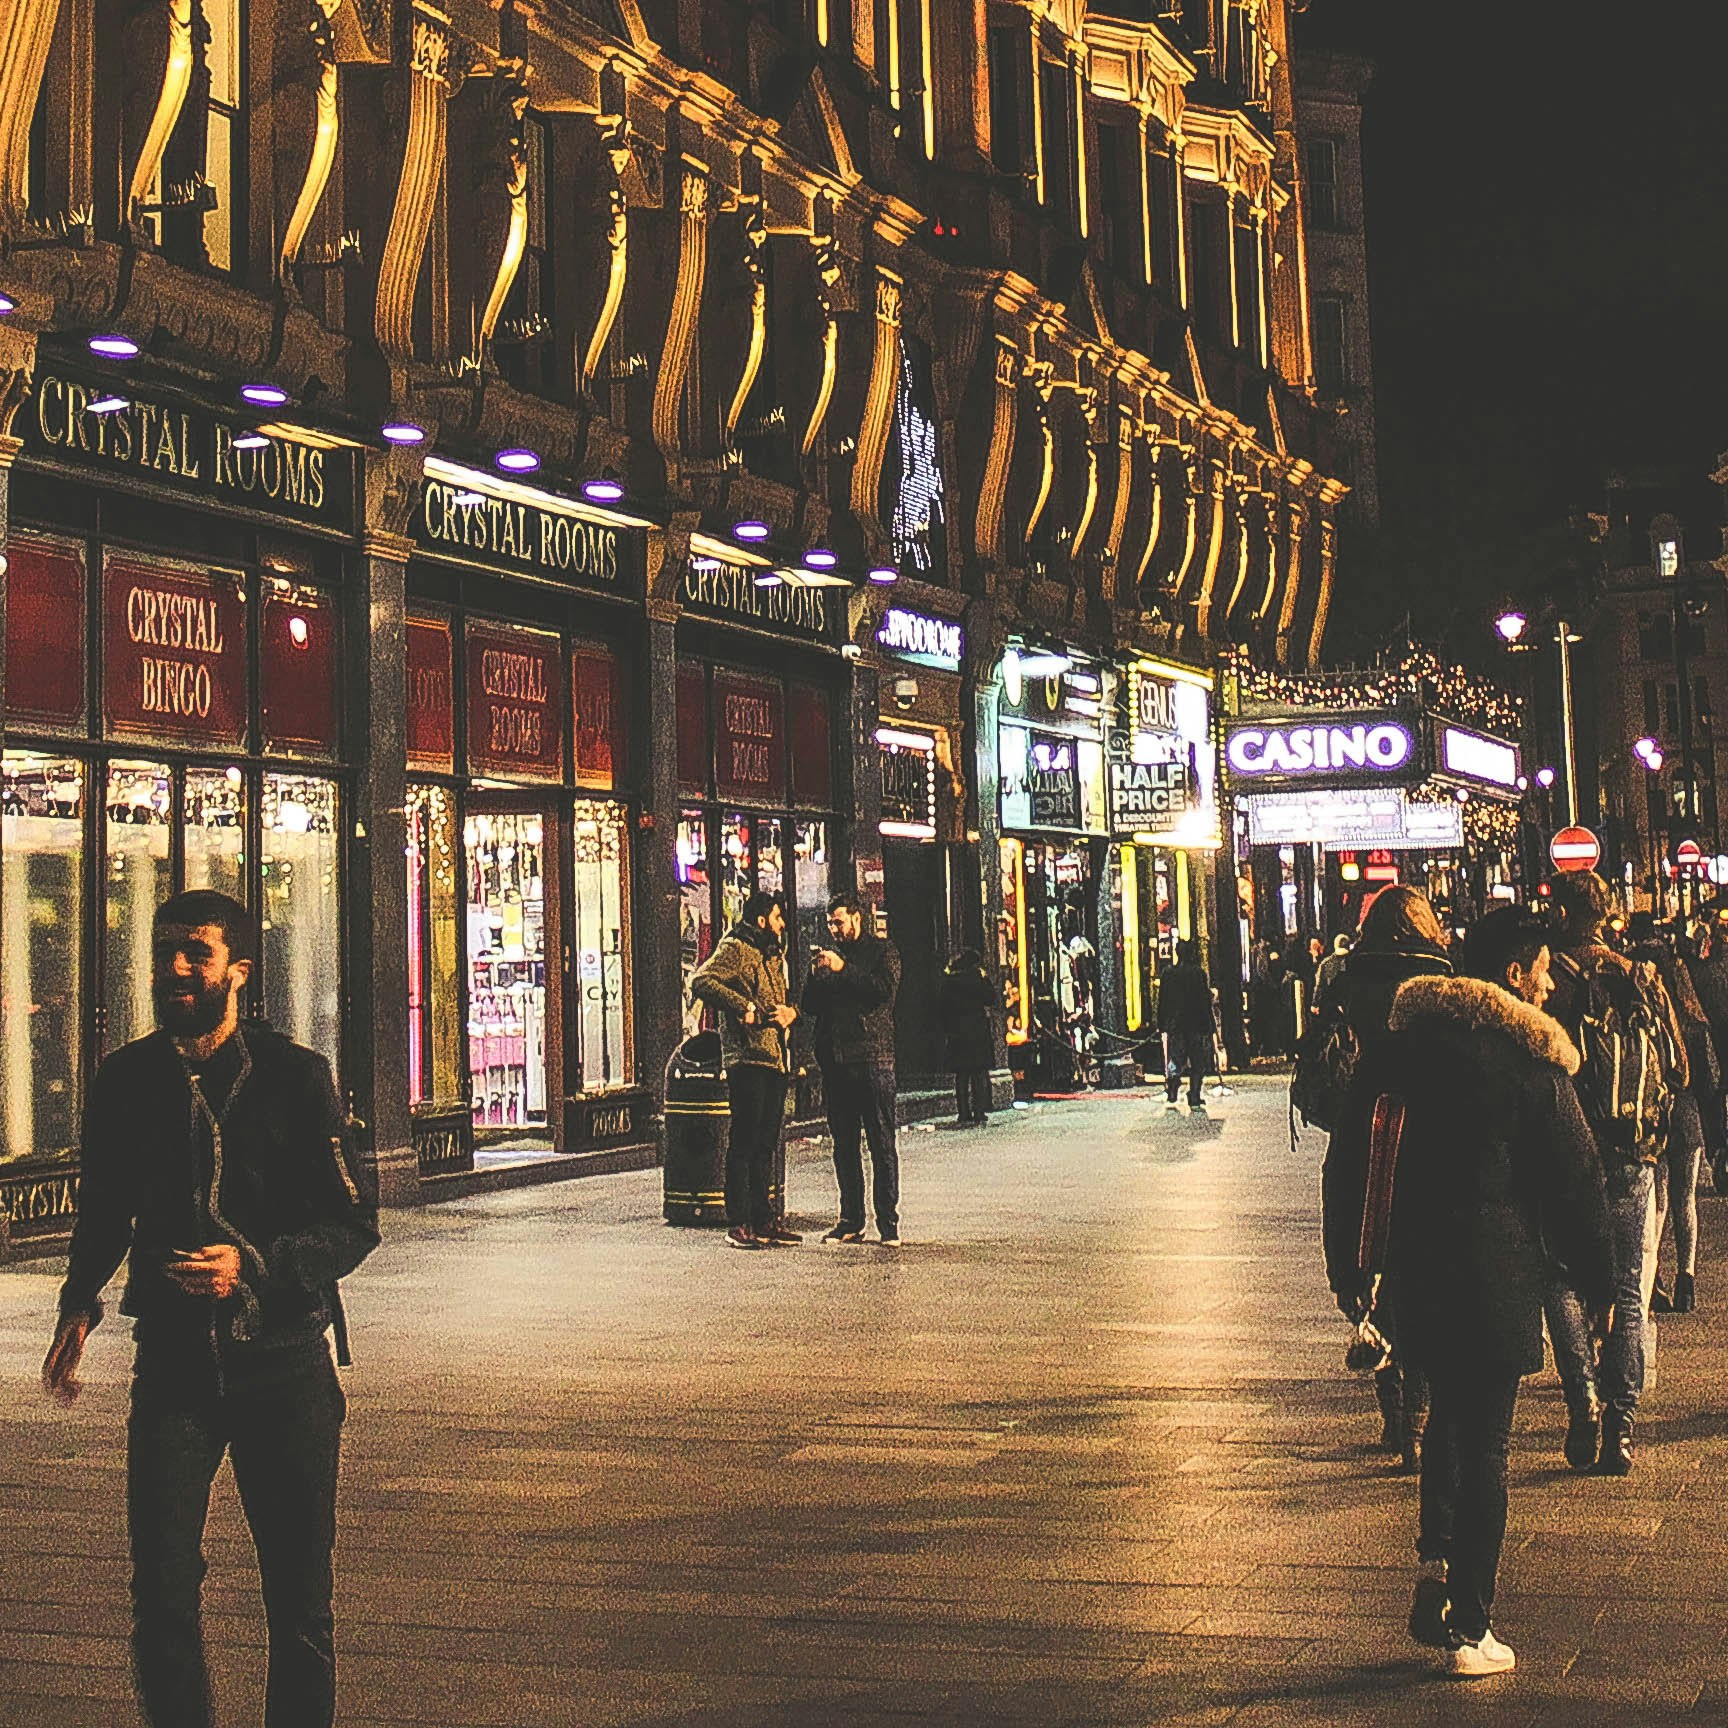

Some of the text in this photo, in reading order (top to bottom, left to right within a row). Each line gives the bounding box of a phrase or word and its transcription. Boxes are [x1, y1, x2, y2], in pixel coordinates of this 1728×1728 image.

[38, 375, 325, 509] CRYSTAL ROOMS
[424, 481, 618, 581] CRYSTAL ROOMS
[127, 586, 223, 654] CRYSTAL
[685, 556, 825, 632] CRYSTAL ROOMS
[141, 656, 211, 717] BINGO
[481, 648, 548, 704] CRYSTAL
[489, 705, 541, 756] ROOMS
[1227, 724, 1409, 771] CASINO
[1111, 764, 1185, 789] HALF
[1112, 789, 1186, 811] PRICE
